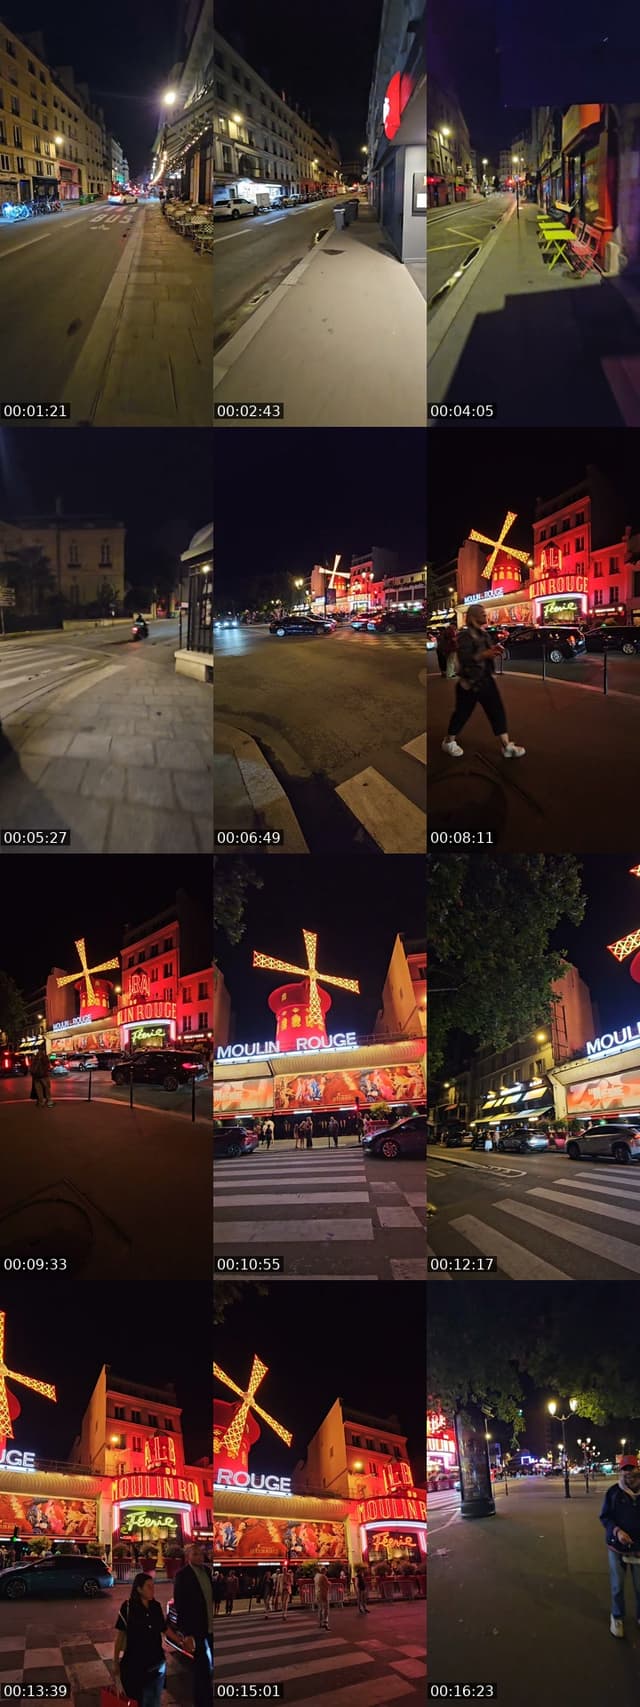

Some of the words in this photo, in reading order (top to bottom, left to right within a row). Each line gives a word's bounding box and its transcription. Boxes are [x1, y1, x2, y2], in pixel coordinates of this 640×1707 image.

[89, 214, 133, 224] BUS
[548, 576, 588, 595] ROUGE
[137, 1002, 177, 1020] ROUGE
[216, 1041, 281, 1059] MOULIN
[296, 1032, 357, 1051] ROUGE
[111, 1475, 175, 1501] MOULIN
[216, 1468, 292, 1493] ROUGE
[357, 1498, 418, 1522] MOULIN
